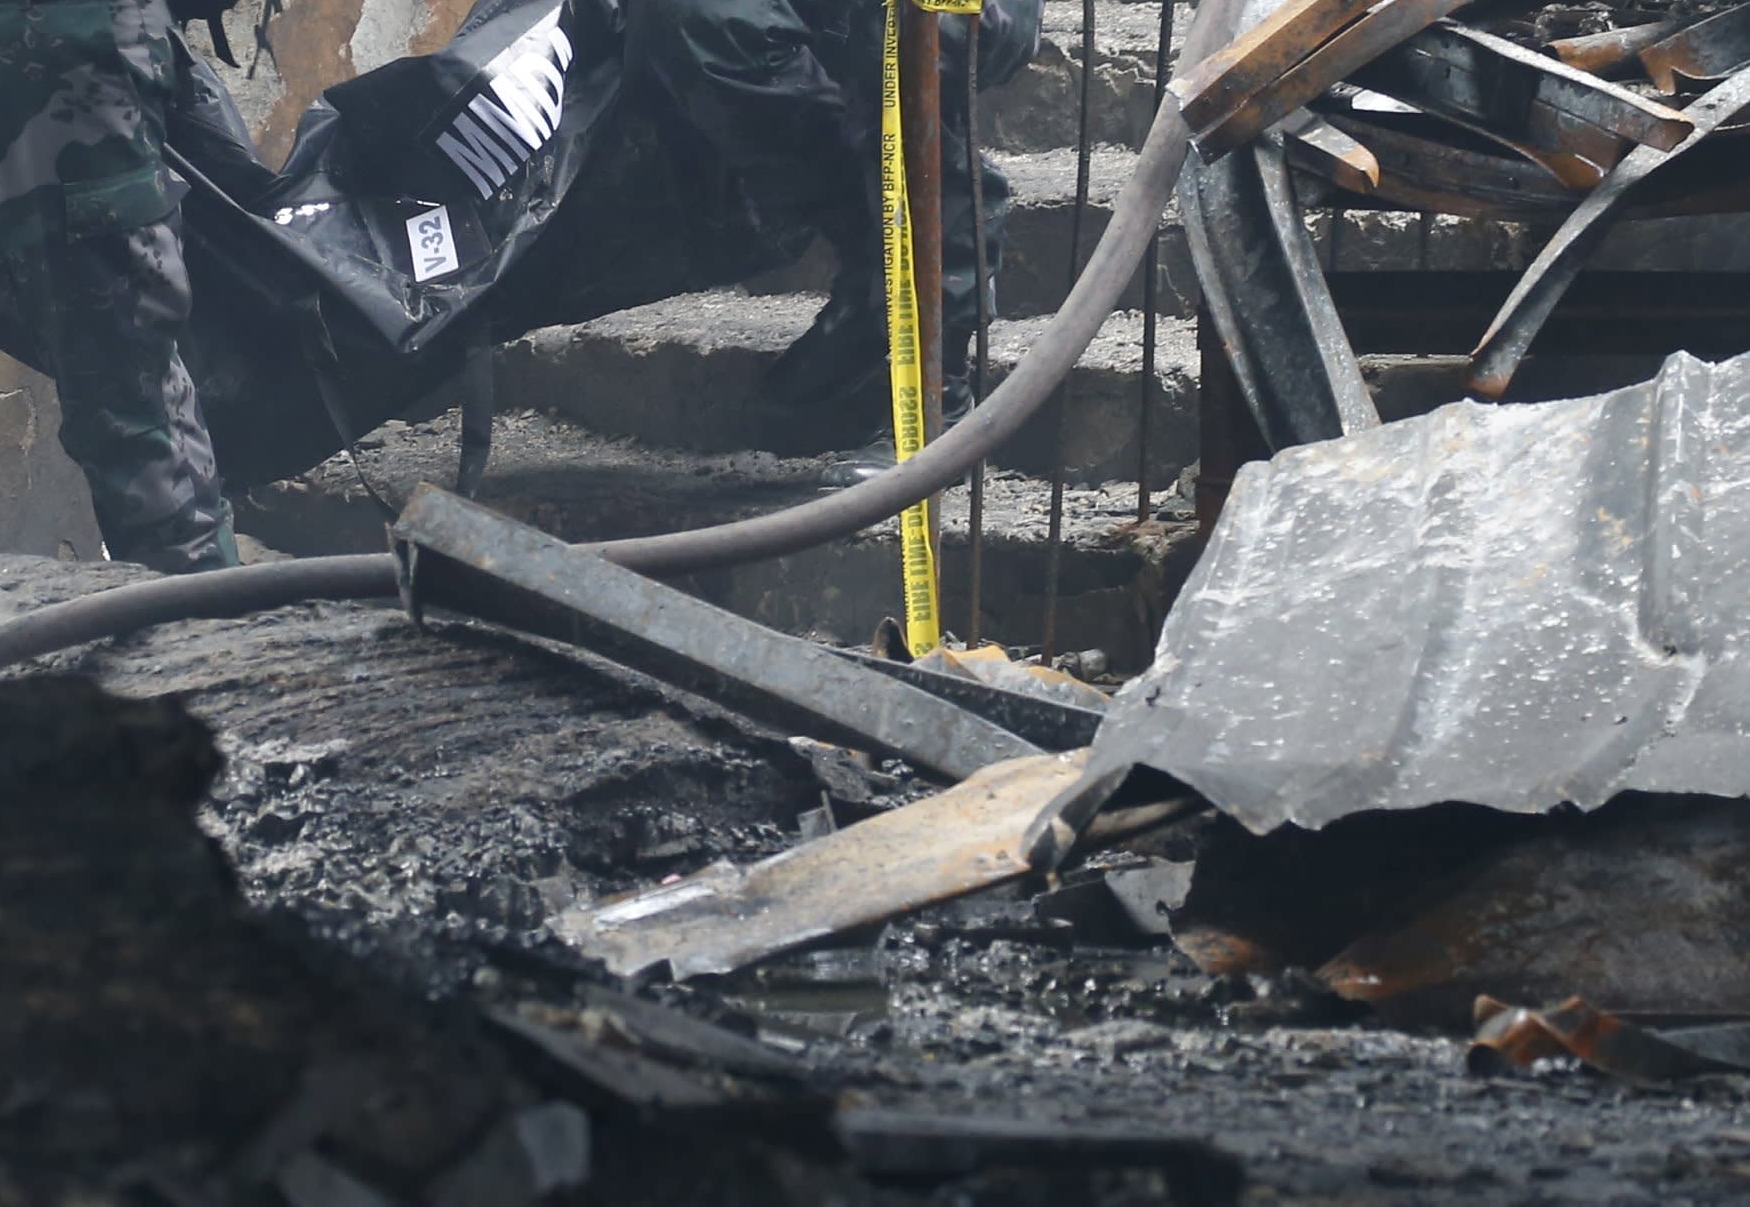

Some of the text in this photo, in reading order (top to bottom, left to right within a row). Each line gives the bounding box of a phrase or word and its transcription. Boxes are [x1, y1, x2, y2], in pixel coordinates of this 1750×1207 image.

[884, 63, 895, 108] UNDER
[883, 133, 895, 192] BFP-NCR
[882, 195, 894, 213] BY
[418, 215, 447, 273] V-32
